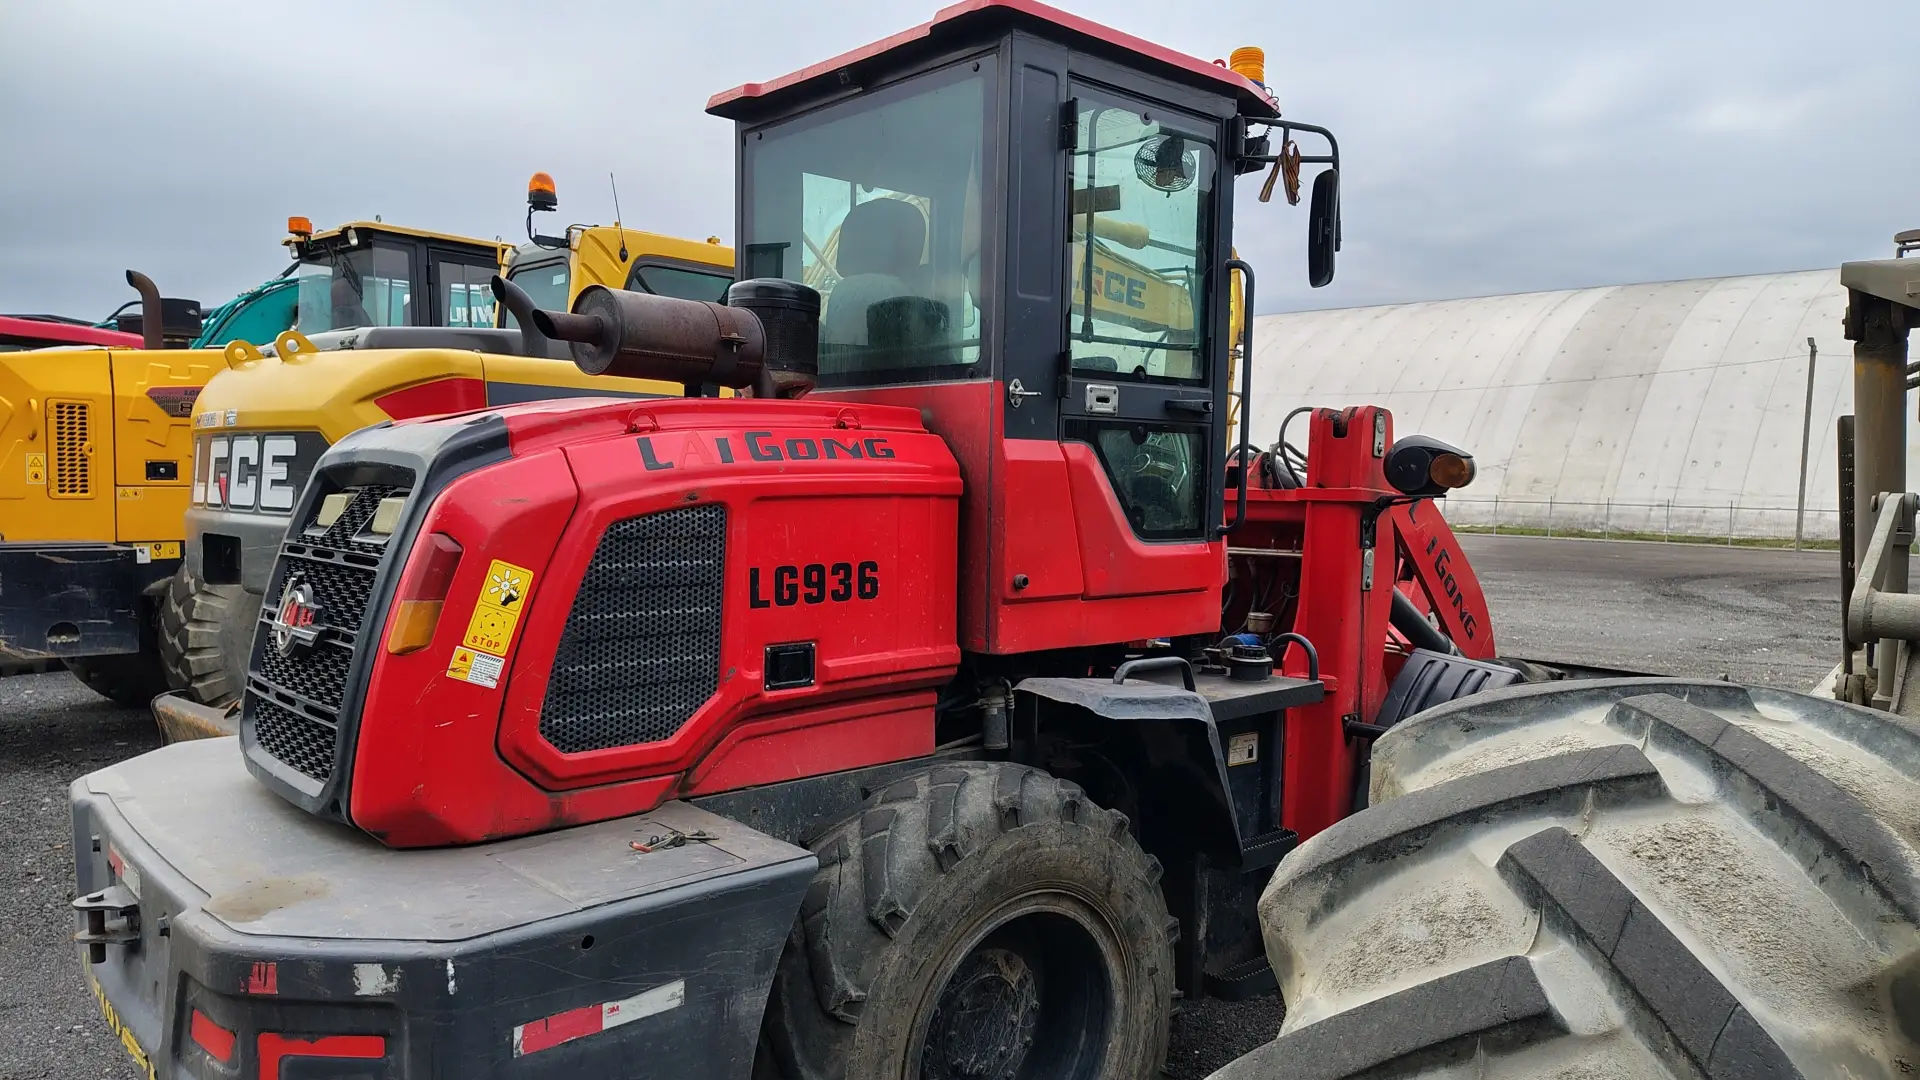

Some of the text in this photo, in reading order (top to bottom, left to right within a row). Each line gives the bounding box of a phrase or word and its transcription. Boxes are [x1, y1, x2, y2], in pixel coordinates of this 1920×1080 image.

[193, 435, 297, 508] LGCE
[749, 560, 879, 609] LG936
[471, 635, 500, 650] STOP
